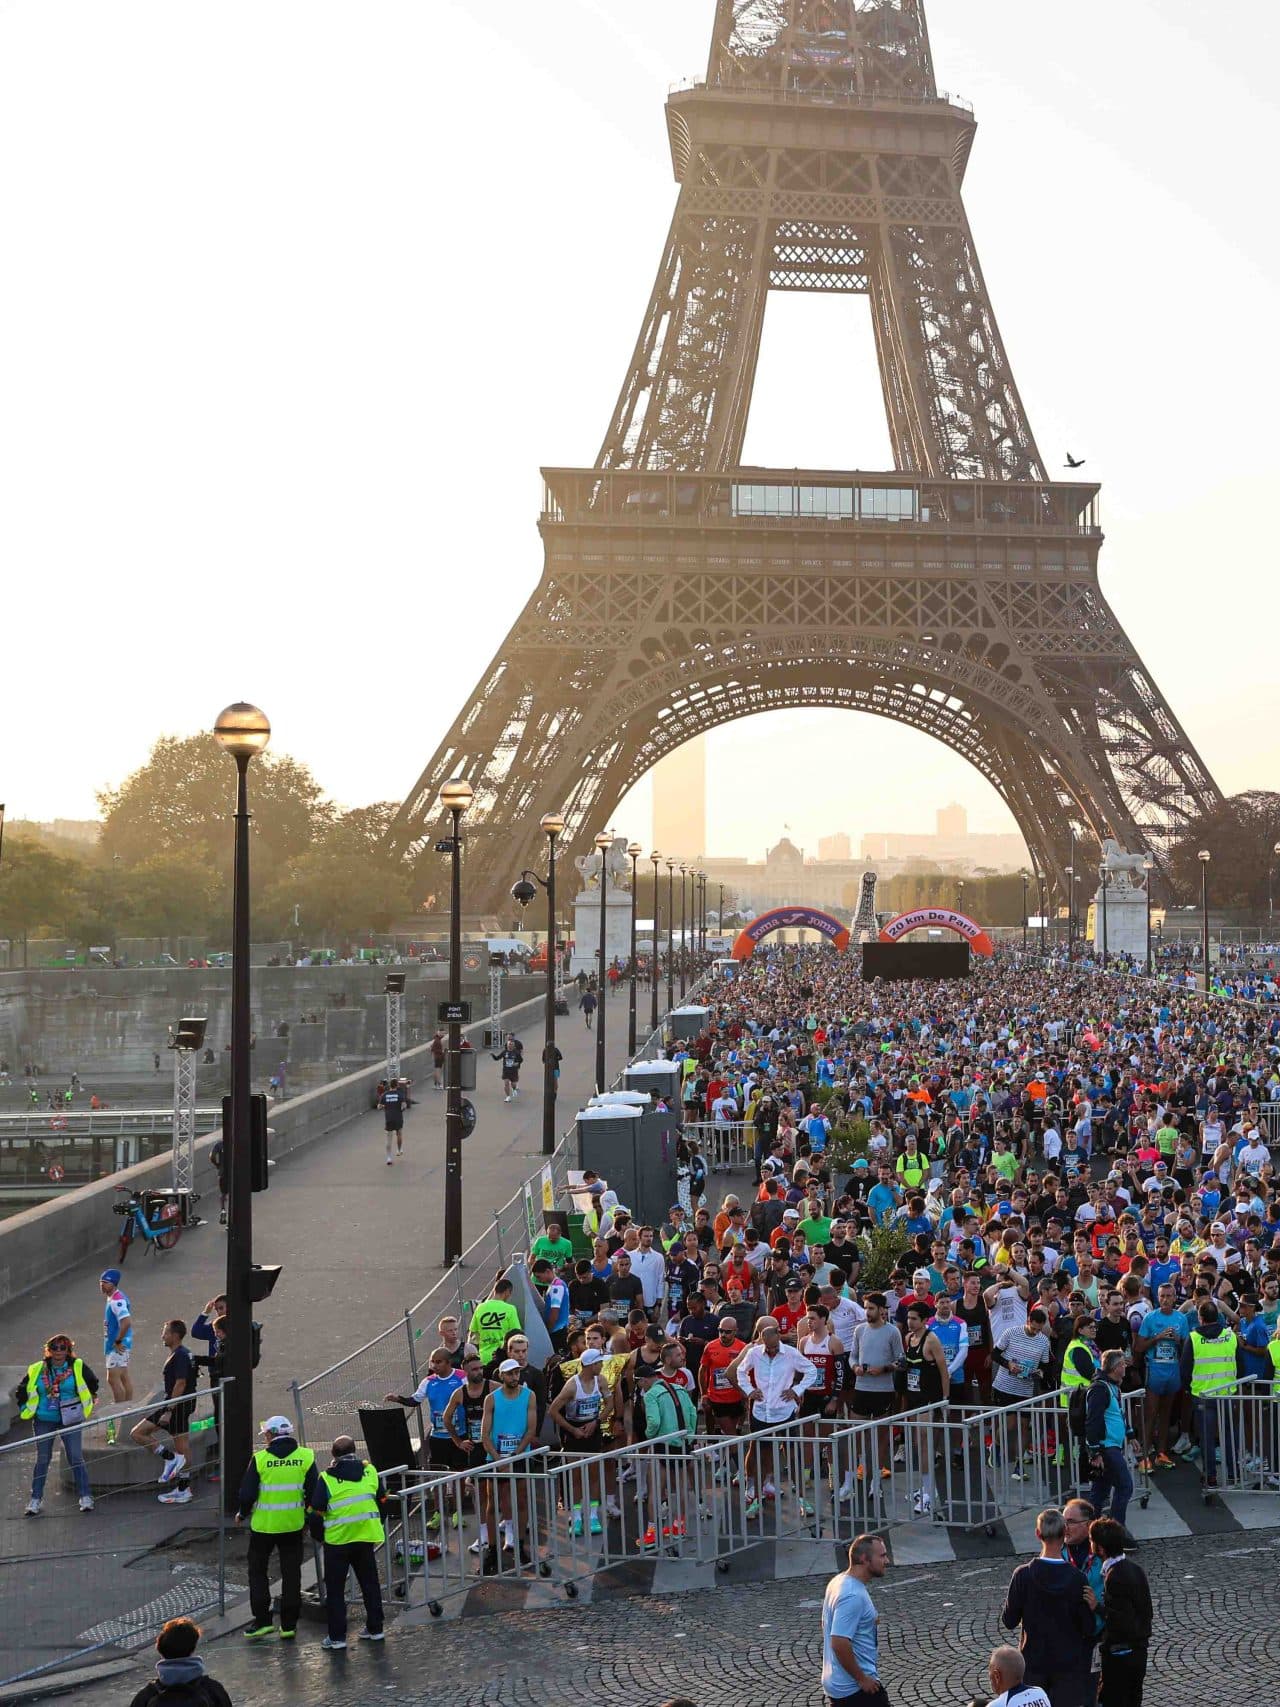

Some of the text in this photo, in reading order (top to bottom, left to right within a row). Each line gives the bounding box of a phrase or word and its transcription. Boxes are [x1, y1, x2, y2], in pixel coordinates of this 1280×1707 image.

[888, 912, 977, 937] 20 km De Paris
[267, 1459, 303, 1468] DEPART
